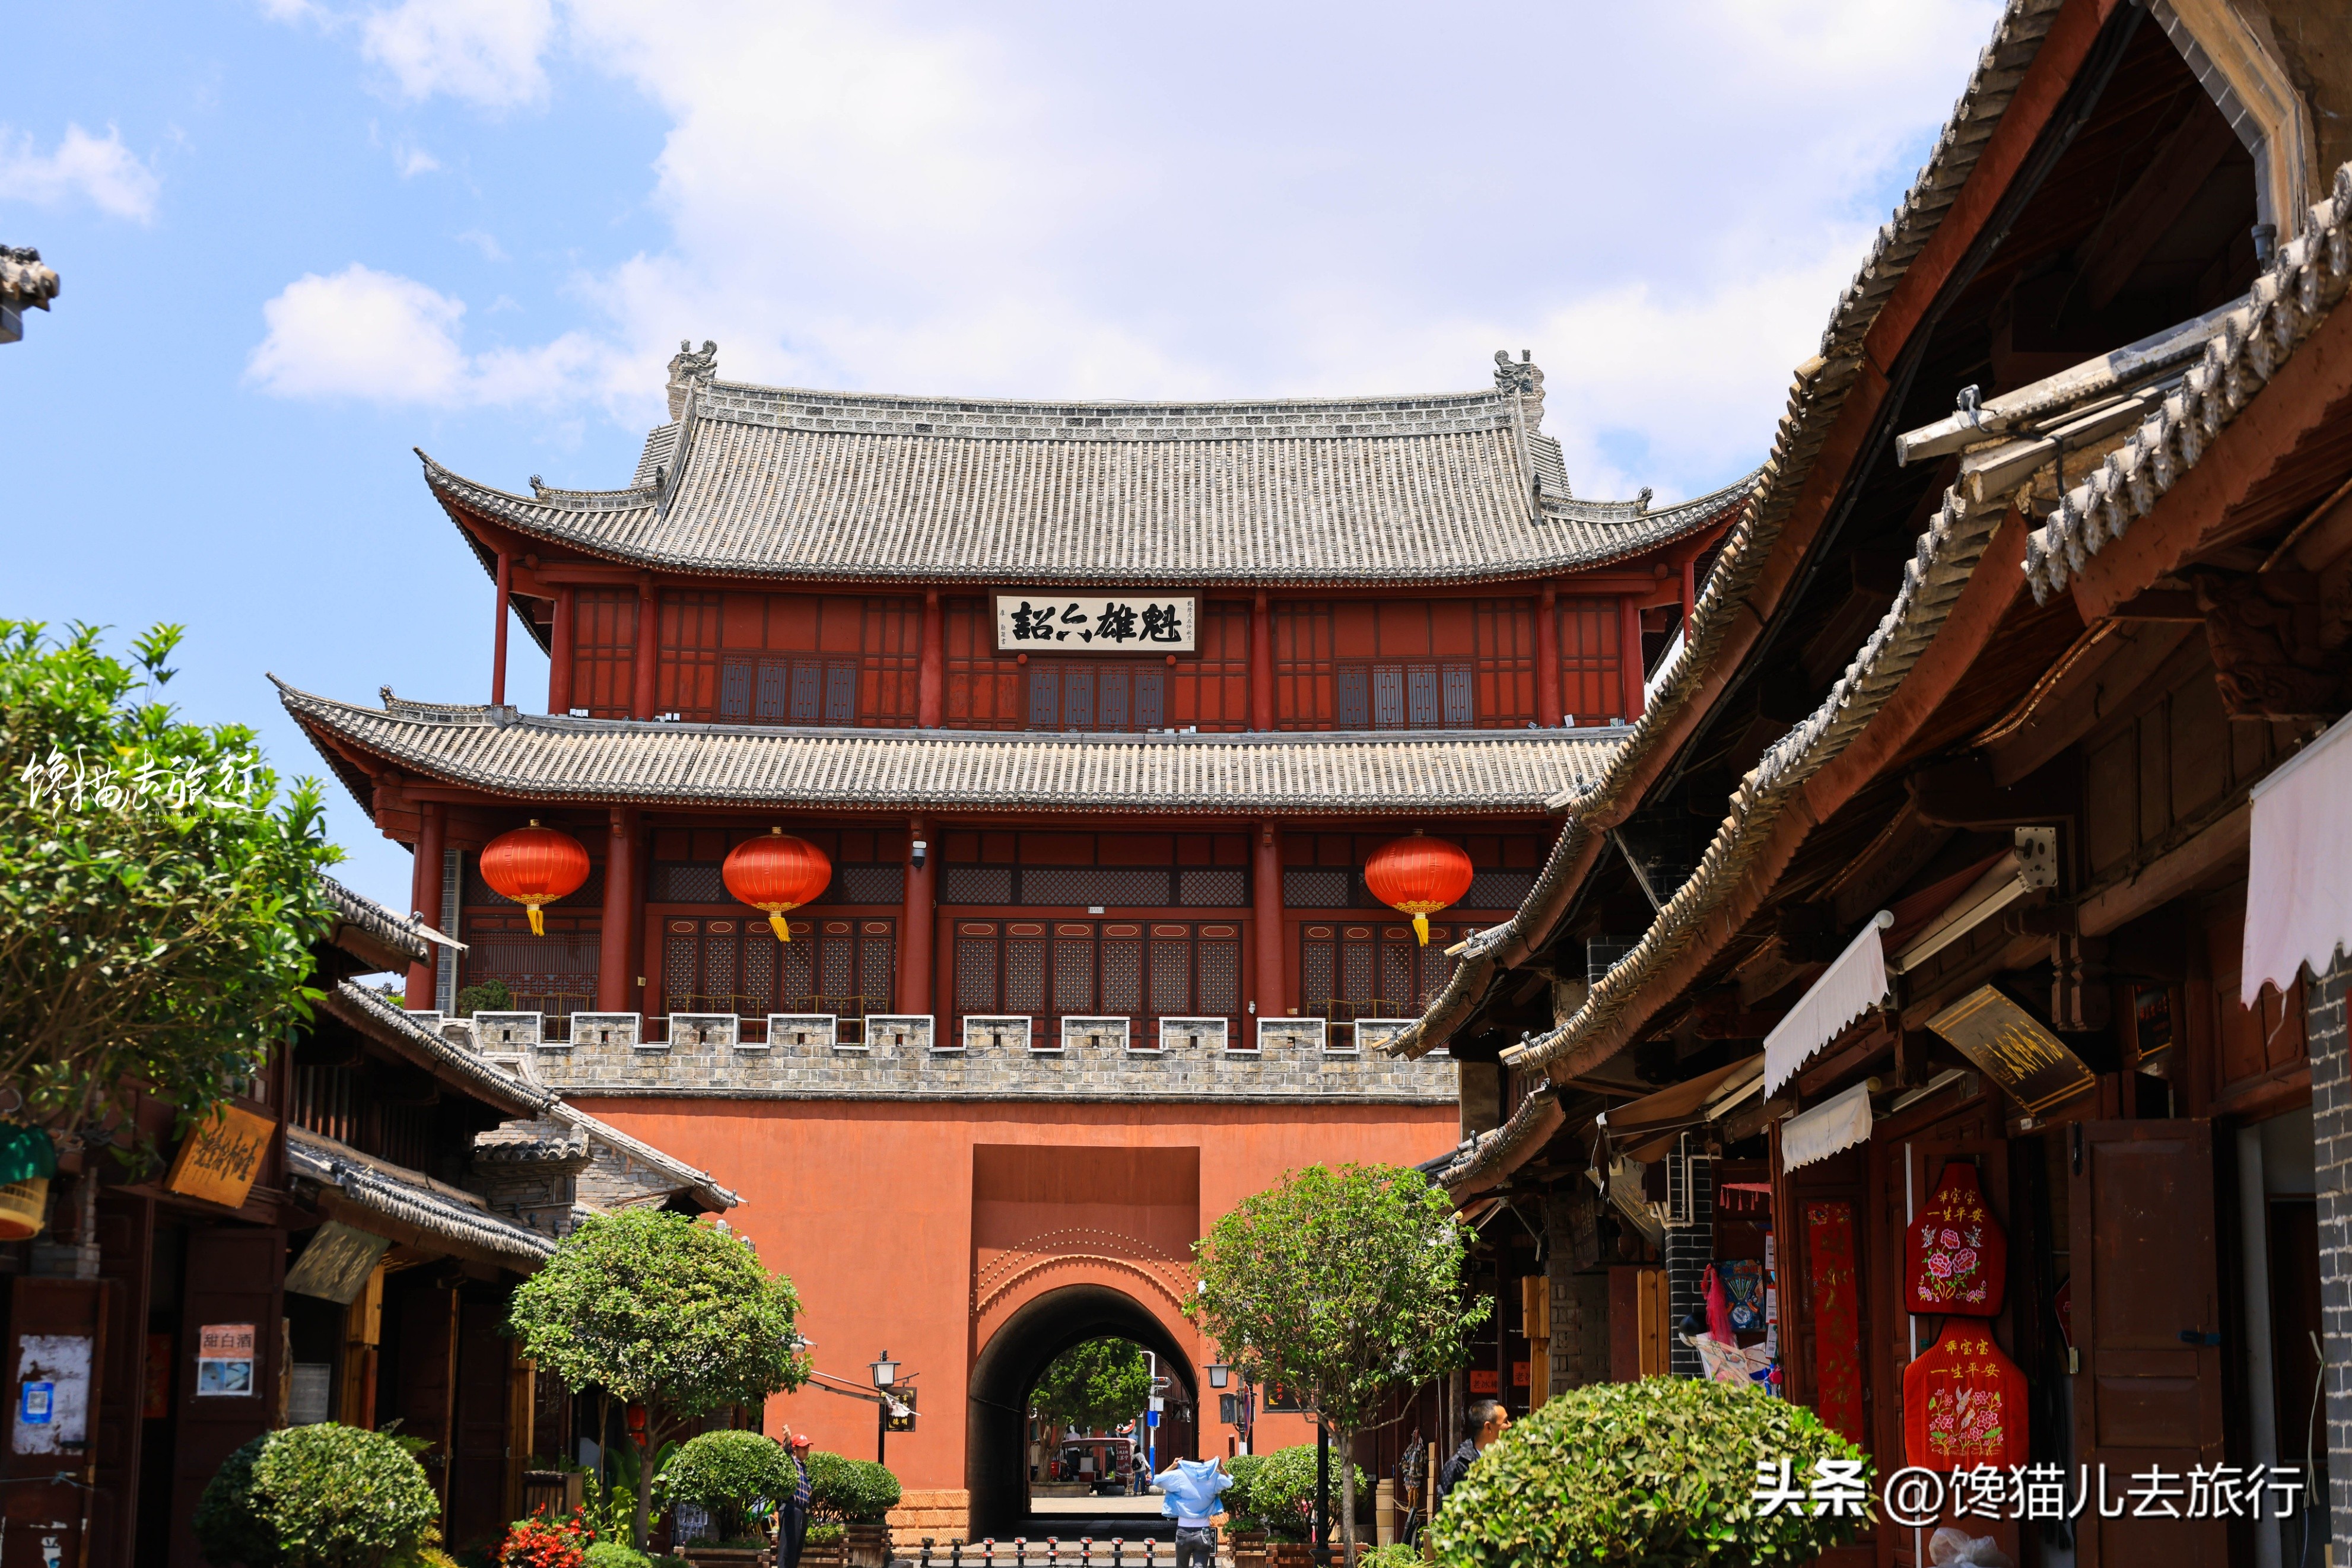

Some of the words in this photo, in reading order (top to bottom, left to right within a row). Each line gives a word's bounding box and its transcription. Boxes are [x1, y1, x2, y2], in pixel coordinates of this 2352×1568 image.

[1938, 1187, 1976, 1205] 乖宝宝
[1927, 1206, 1985, 1223] 一生平安
[204, 1334, 252, 1348] 甜白酒
[1944, 1338, 1989, 1356] 乖宝宝
[1930, 1362, 2000, 1379] 一生平安
